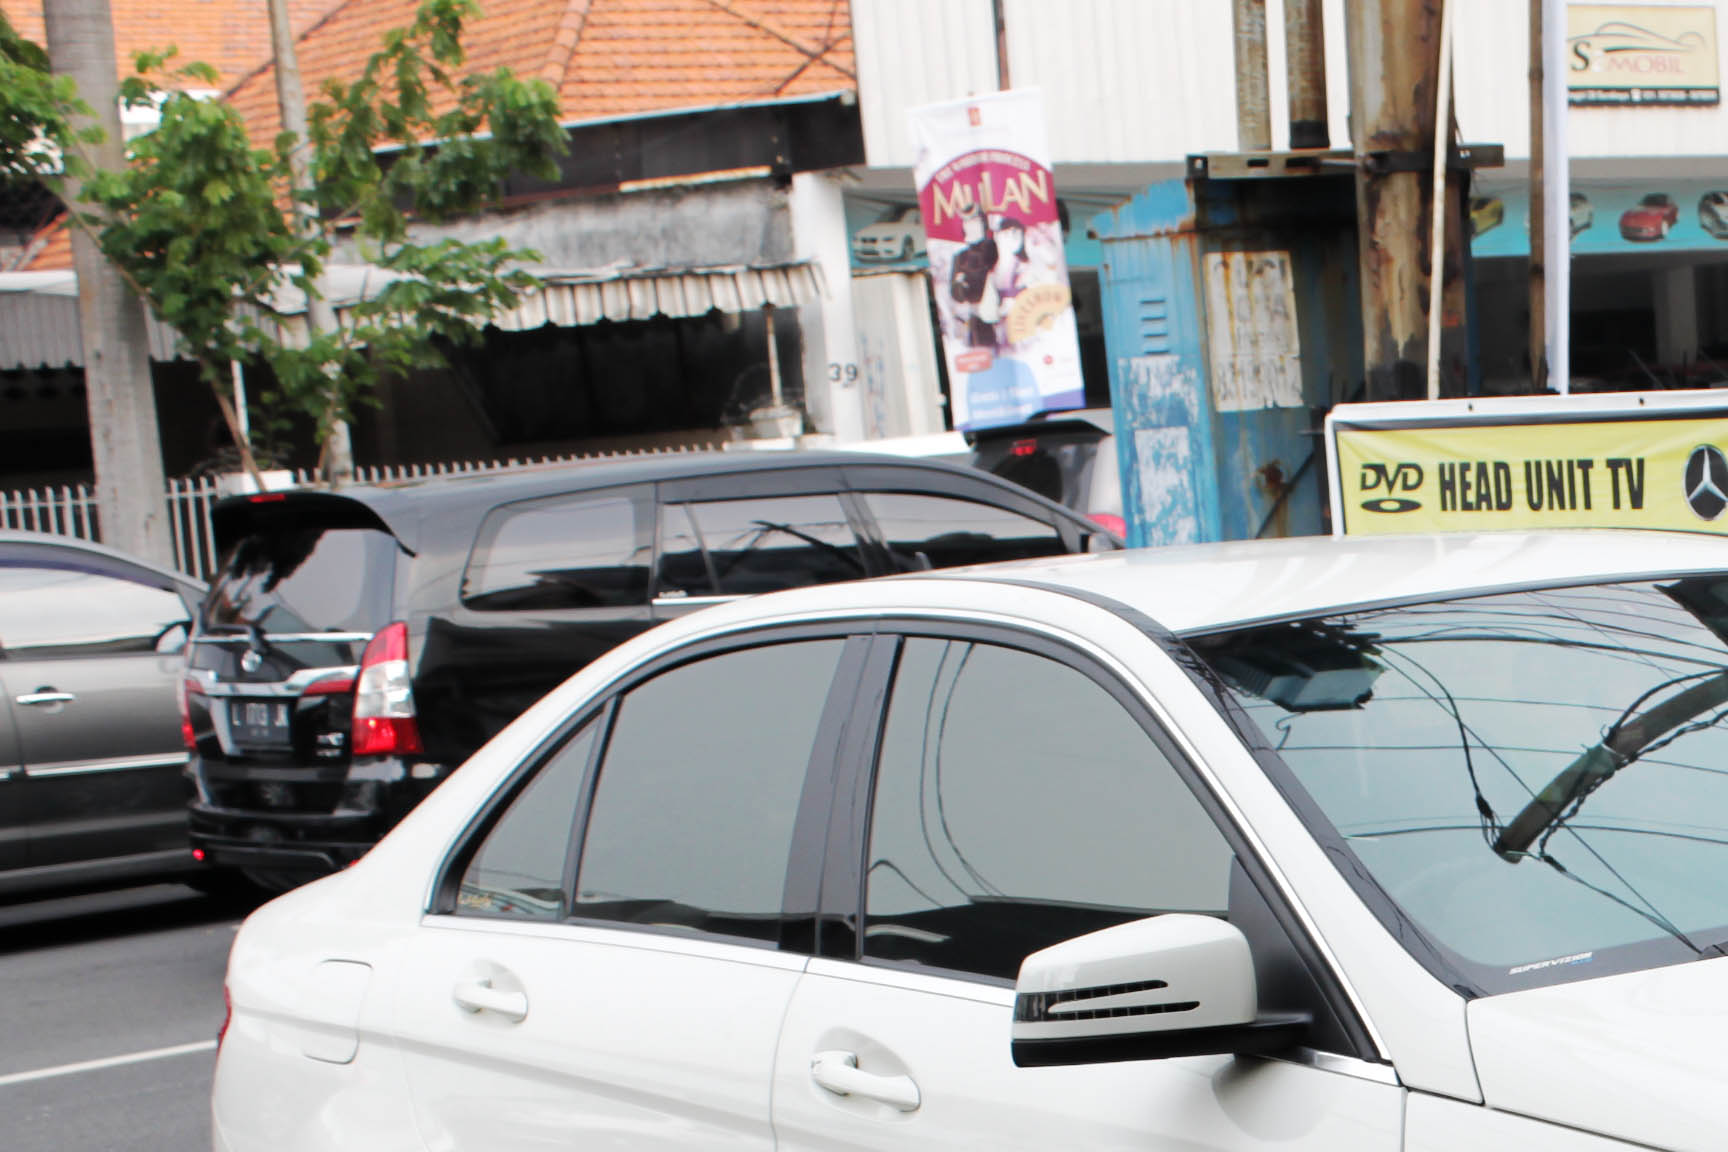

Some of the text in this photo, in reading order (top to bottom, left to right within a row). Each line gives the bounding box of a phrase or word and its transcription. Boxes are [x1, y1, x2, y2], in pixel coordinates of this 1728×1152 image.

[931, 168, 1049, 226] MULAN
[828, 362, 858, 383] 39
[1360, 457, 1646, 512] DVD HEAD UNIT TV
